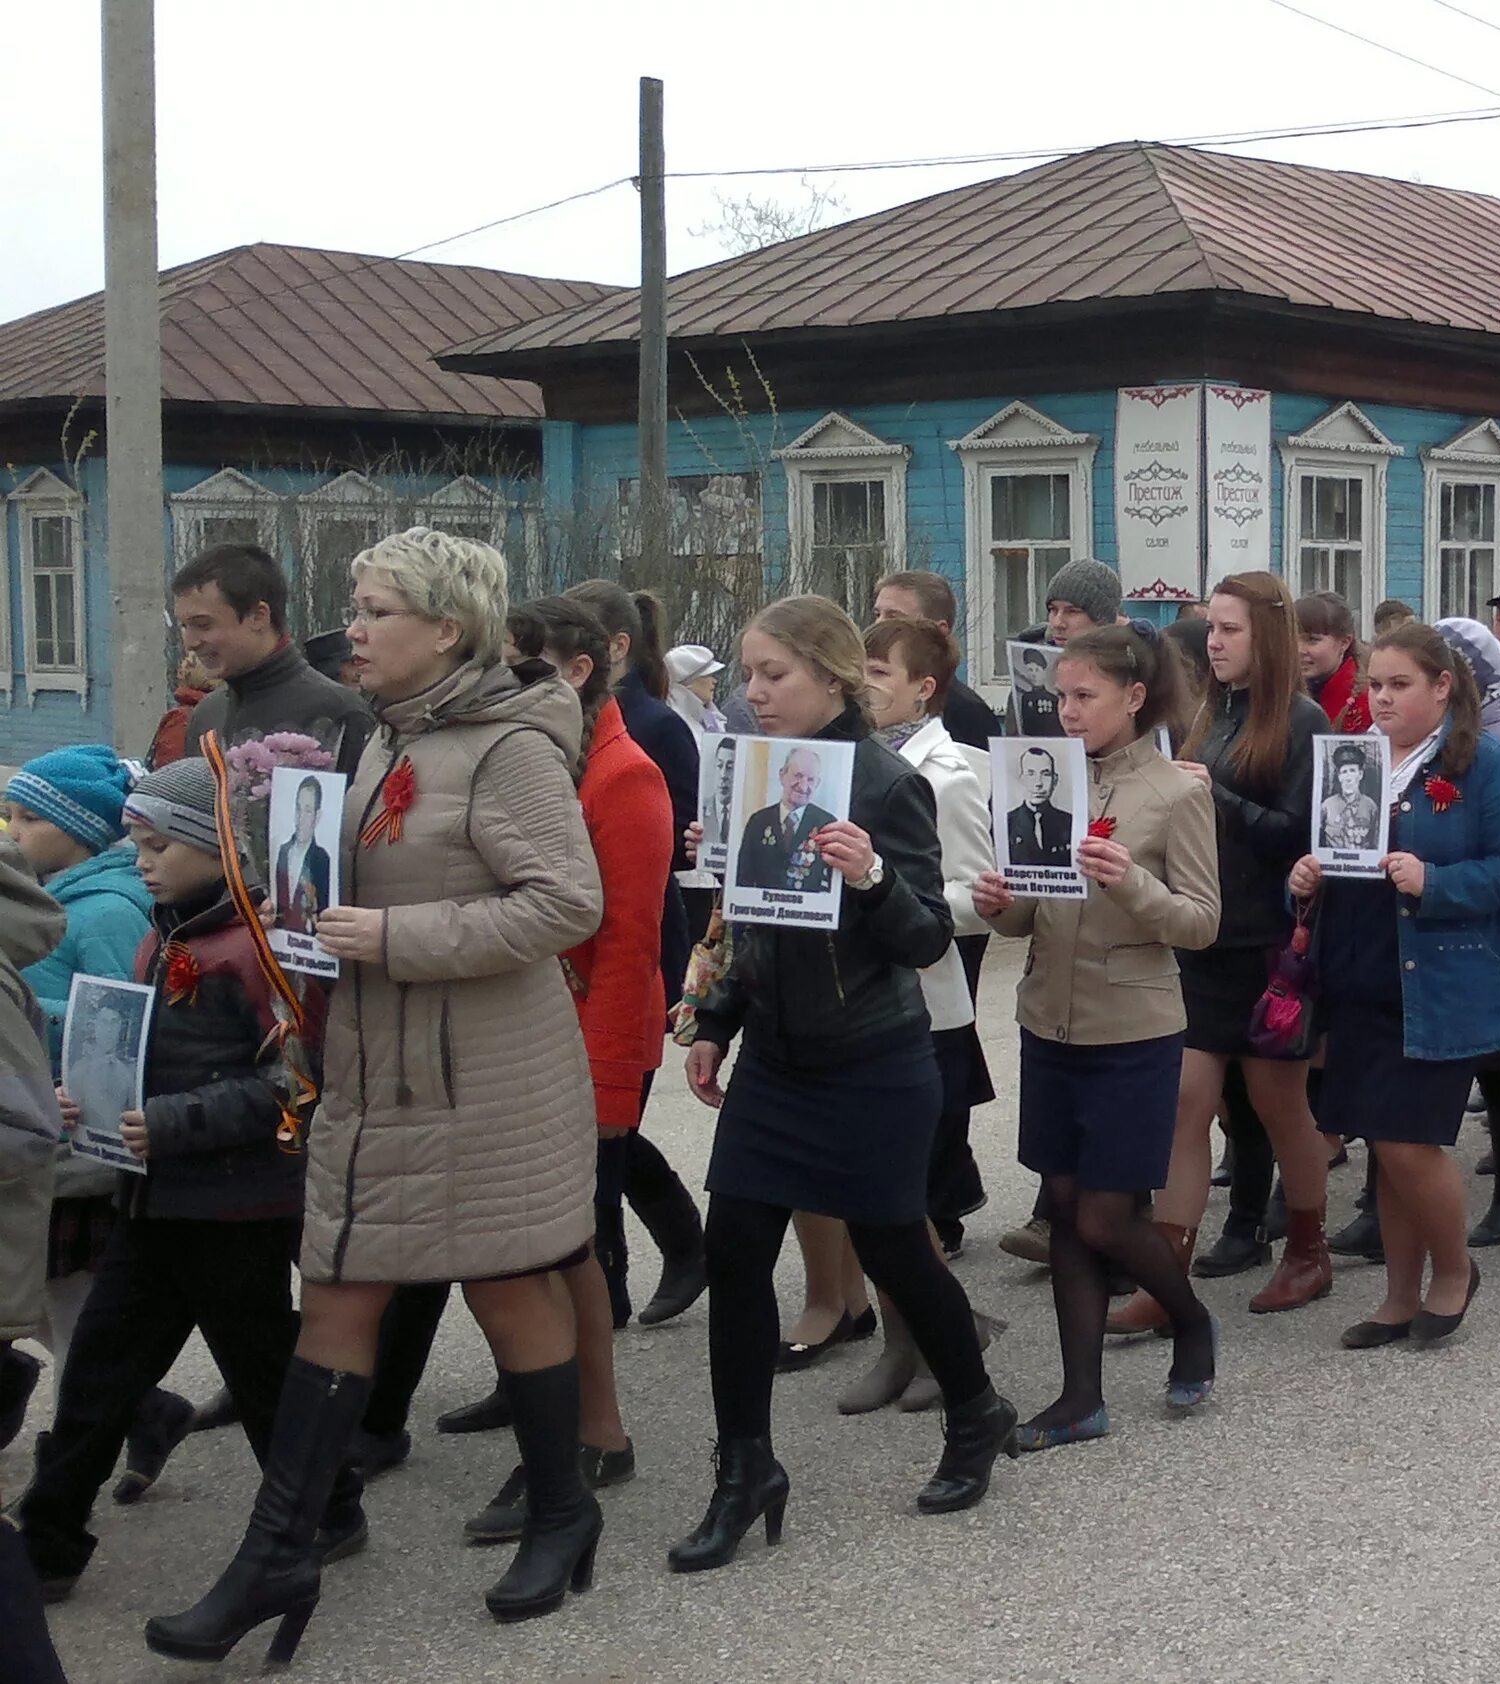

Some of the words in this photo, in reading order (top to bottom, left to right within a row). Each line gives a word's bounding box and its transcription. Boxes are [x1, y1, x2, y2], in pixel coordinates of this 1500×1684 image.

[1128, 482, 1183, 505] Престиж
[1217, 482, 1260, 505] Престиж
[1004, 868, 1078, 880] Шерстобитов
[1030, 882, 1083, 895] Петрович
[729, 902, 776, 918] Григорий
[776, 907, 833, 922] Данилович
